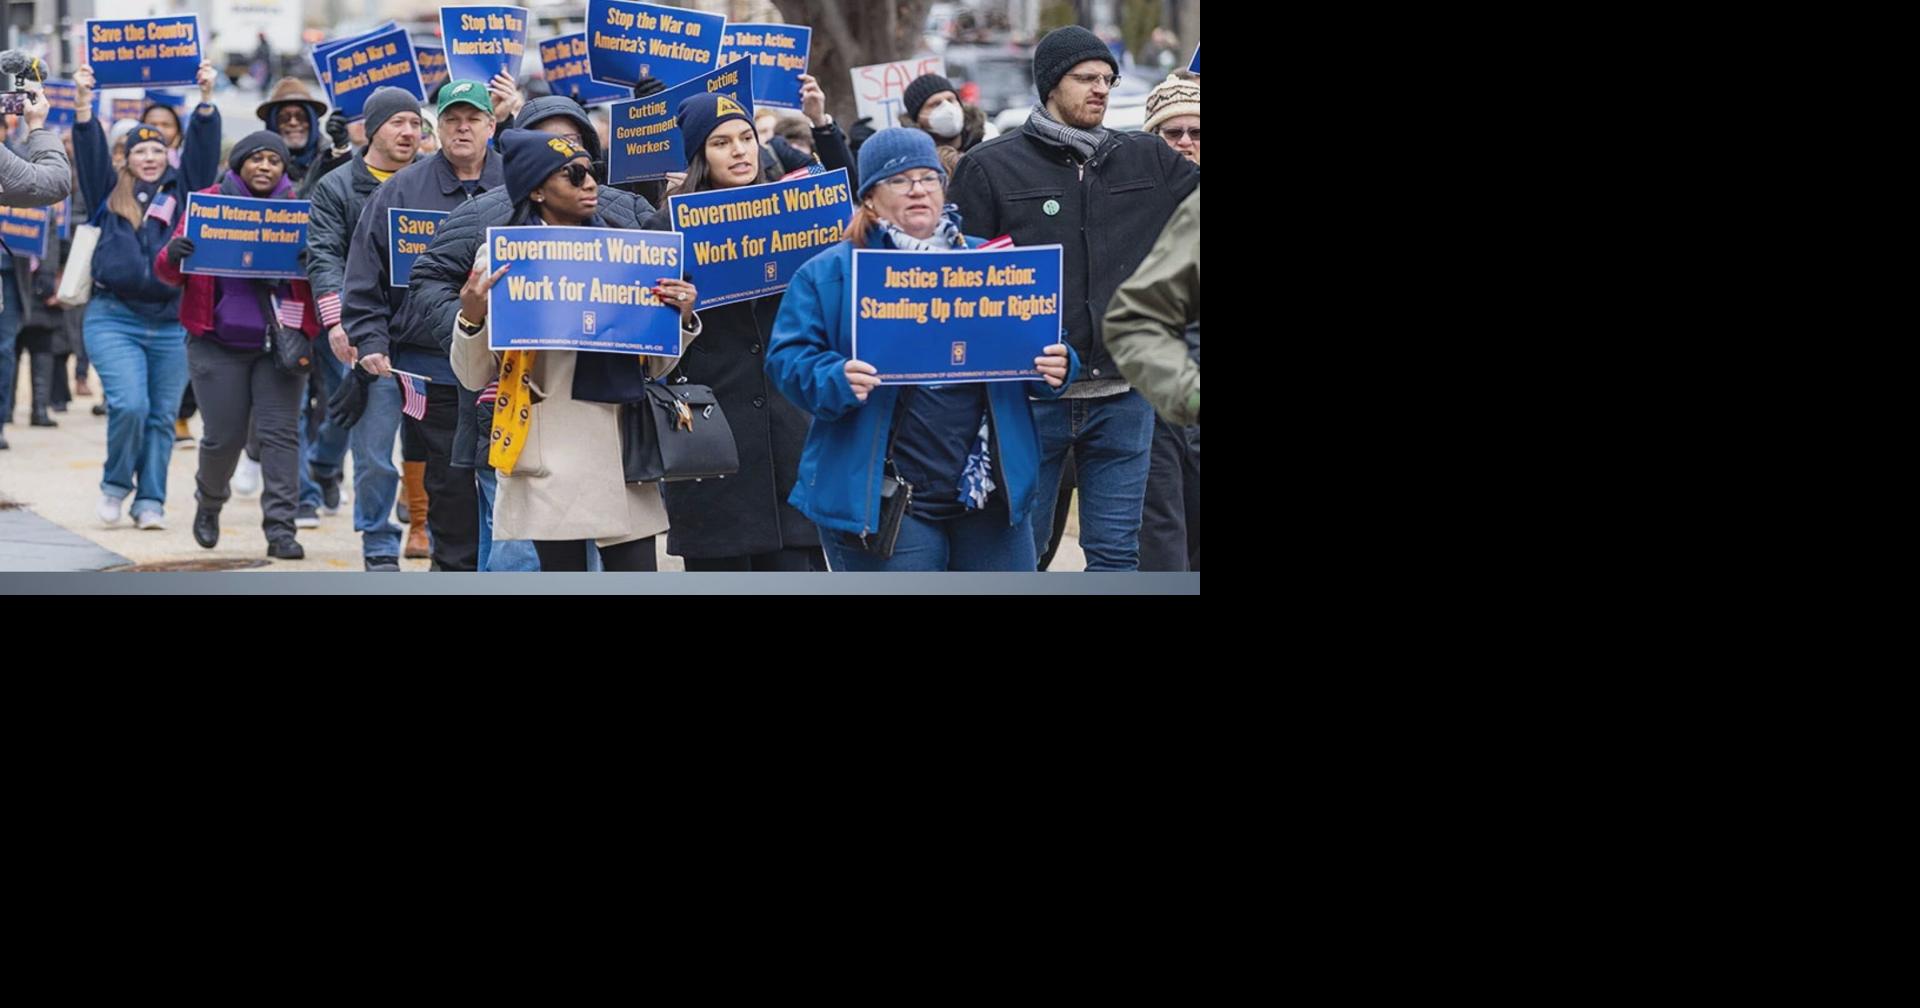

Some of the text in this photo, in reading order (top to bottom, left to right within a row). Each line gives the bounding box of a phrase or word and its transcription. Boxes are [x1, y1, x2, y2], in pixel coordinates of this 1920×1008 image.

[92, 22, 194, 42] Save the Country
[461, 14, 486, 33] Stop
[487, 13, 504, 30] the
[607, 7, 701, 37] Stop the War on
[452, 37, 502, 55] America's
[594, 30, 647, 54] America's
[648, 38, 711, 64] Workforce
[736, 32, 763, 47] Takes
[92, 42, 198, 61] Save the Civil Service!
[337, 42, 397, 72] Stop the War on
[759, 51, 776, 66] Our
[335, 72, 369, 95] America's
[367, 60, 411, 83] Workforce
[707, 70, 738, 93] Cutting
[629, 101, 667, 119] Cutting
[616, 116, 678, 139] Government
[626, 140, 670, 155] Workers
[190, 202, 309, 224] Proud Veteran, Dedicate
[677, 183, 848, 228] Government Workers
[200, 224, 300, 243] Government Worker!
[398, 214, 435, 235] Save
[398, 238, 427, 254] Save
[494, 235, 678, 267] Government Workers
[693, 219, 844, 266] Work for America!
[884, 264, 1036, 288] Justice Takes Action:
[507, 276, 554, 301] Work
[558, 277, 585, 301] for
[860, 293, 1057, 323] Standing Up for Our Rights!
